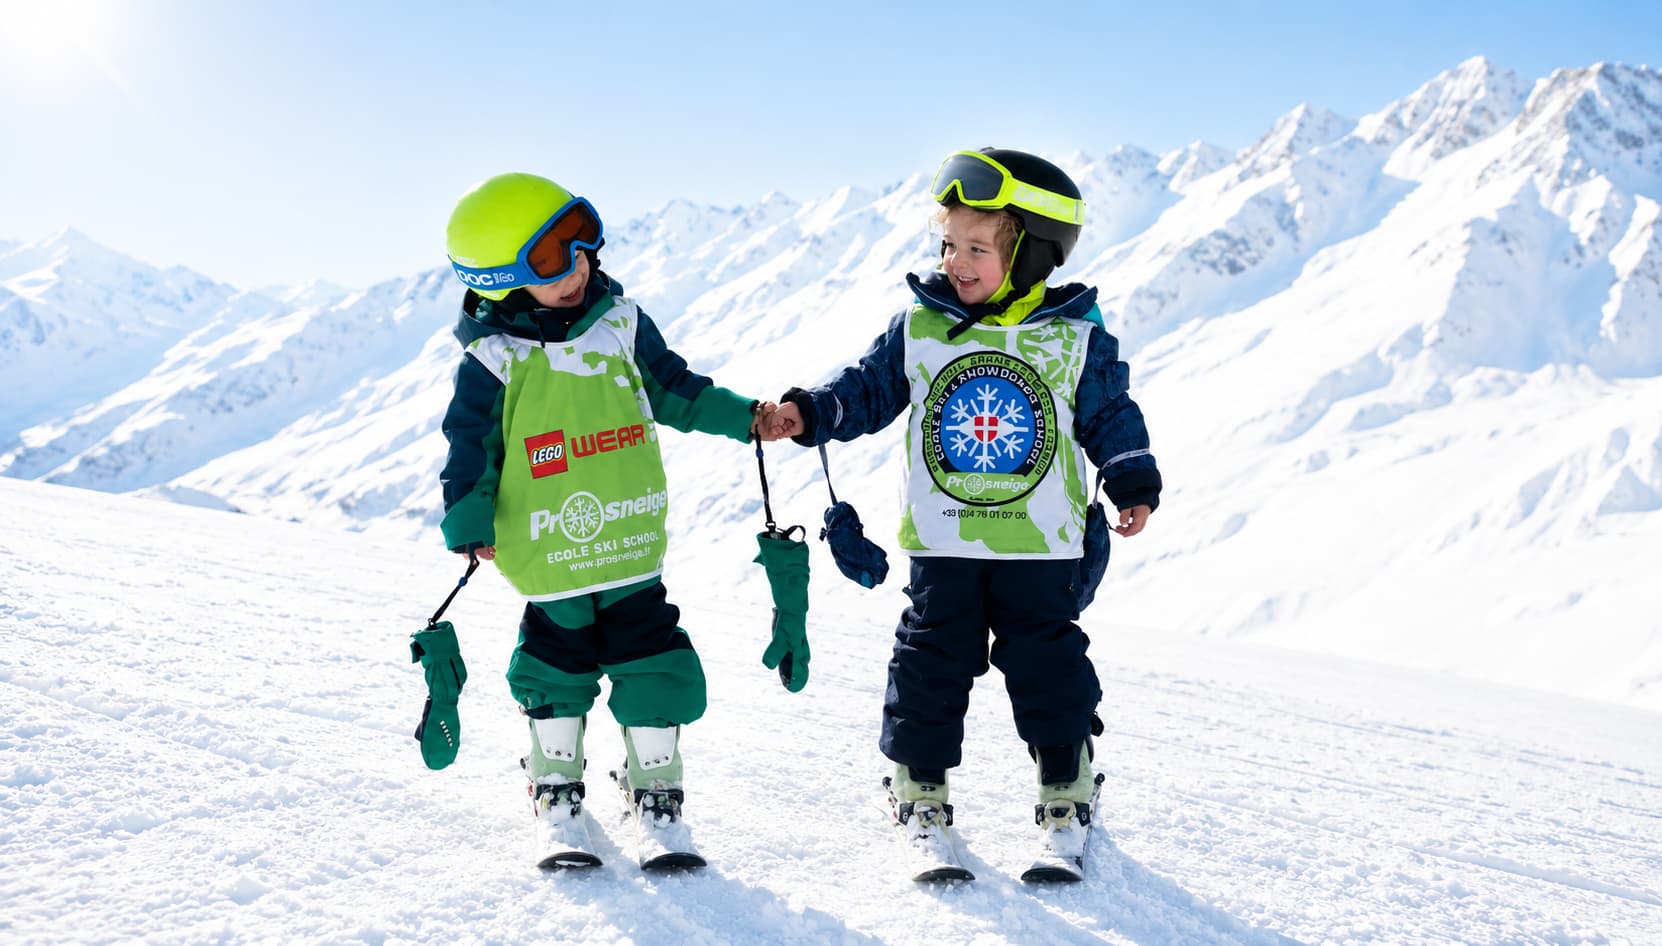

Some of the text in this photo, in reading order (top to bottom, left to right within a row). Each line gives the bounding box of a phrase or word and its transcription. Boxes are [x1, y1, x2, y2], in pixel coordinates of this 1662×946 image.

[532, 423, 647, 466] LEGO WEAR
[546, 531, 660, 565] ECOLE SKI SCHOOL
